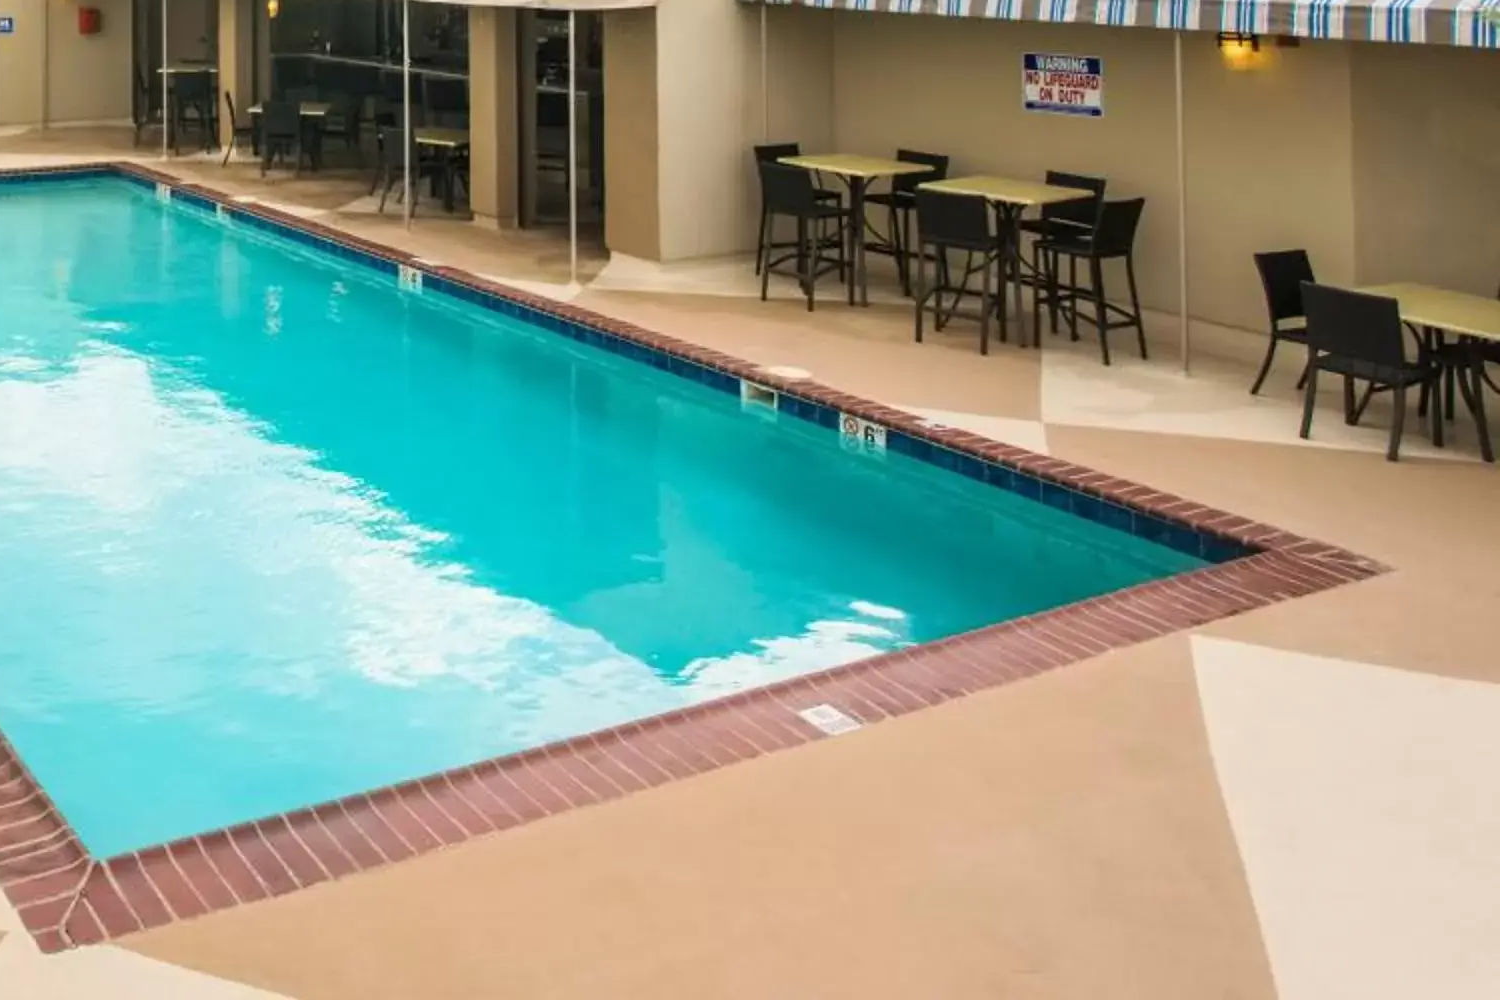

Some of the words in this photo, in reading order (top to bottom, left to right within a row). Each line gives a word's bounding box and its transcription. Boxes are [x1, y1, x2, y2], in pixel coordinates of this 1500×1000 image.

[1035, 55, 1088, 73] WARNING
[1026, 71, 1039, 85] NO
[1044, 72, 1099, 90] LIFEGUARD
[1040, 87, 1052, 101] ON
[1059, 88, 1085, 105] DUTY
